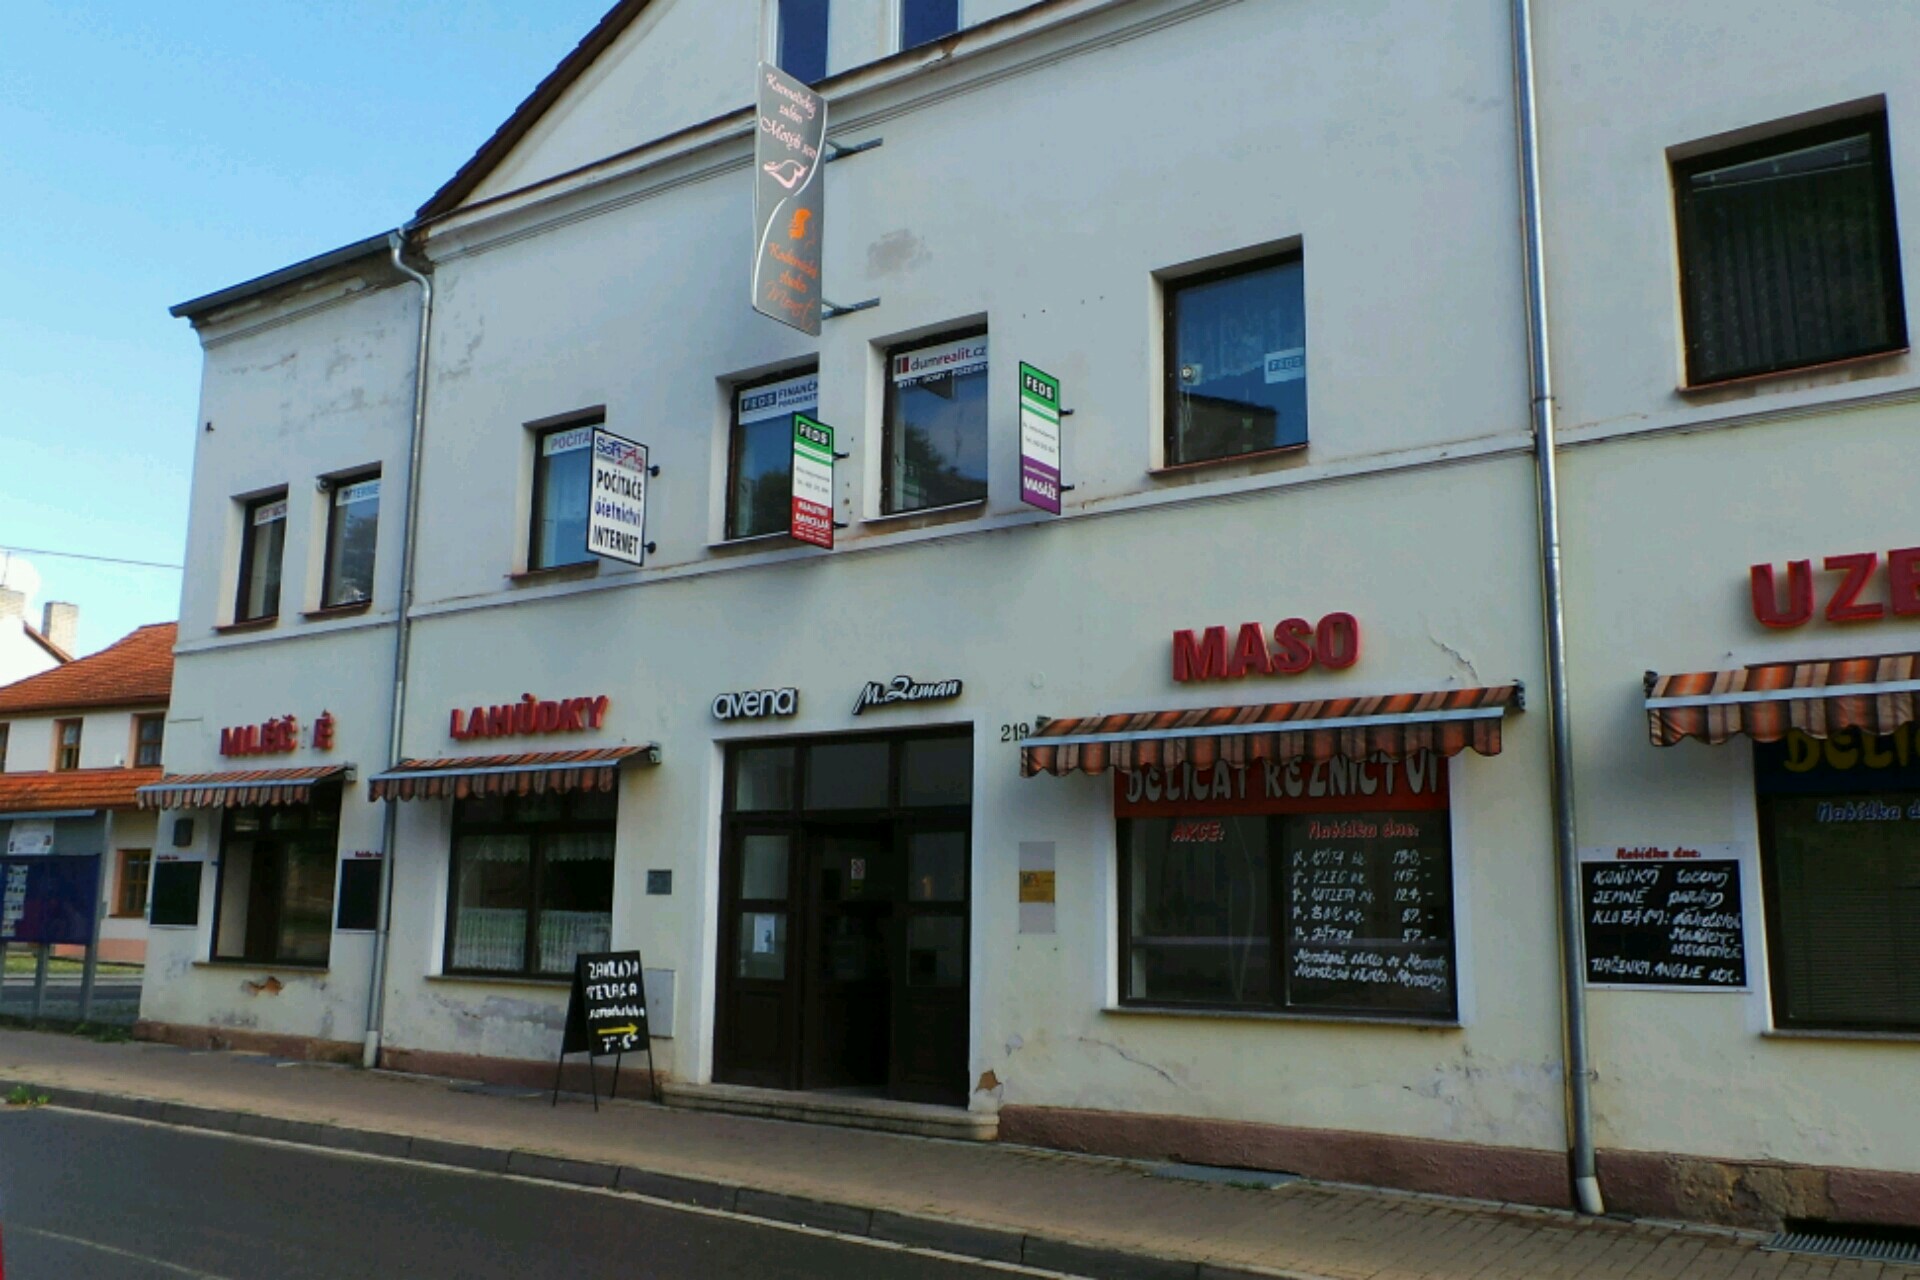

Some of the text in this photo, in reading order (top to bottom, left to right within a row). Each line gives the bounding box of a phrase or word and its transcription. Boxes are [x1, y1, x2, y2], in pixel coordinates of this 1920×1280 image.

[1270, 358, 1302, 372] FEDS
[1026, 376, 1053, 400] FEDS
[799, 423, 828, 445] FEDS
[596, 469, 642, 501] POČÍTAČE
[593, 525, 638, 556] INTERNET
[1171, 611, 1361, 682] MASO
[712, 687, 798, 719] avena
[1001, 723, 1029, 743] 219
[1816, 802, 1900, 822] Nabídka
[586, 982, 638, 1000] TERASA
